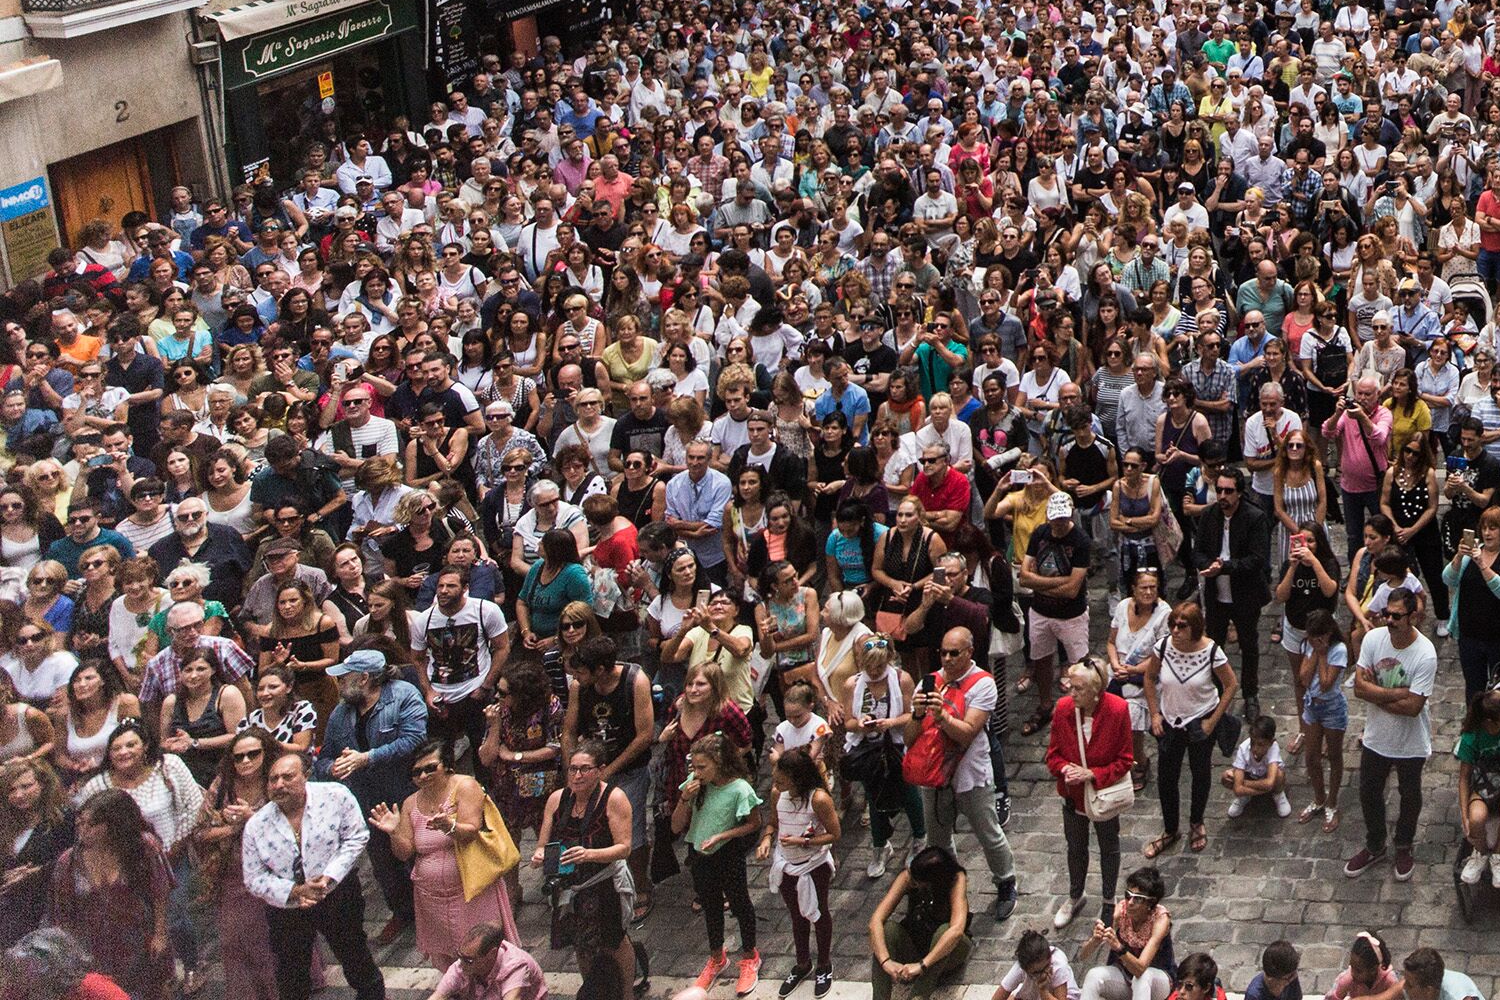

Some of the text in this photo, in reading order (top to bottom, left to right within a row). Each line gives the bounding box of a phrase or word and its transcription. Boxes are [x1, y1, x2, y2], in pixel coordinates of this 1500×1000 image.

[285, 30, 335, 57] Sagrario
[338, 14, 383, 40] Navarro
[114, 100, 130, 123] 2
